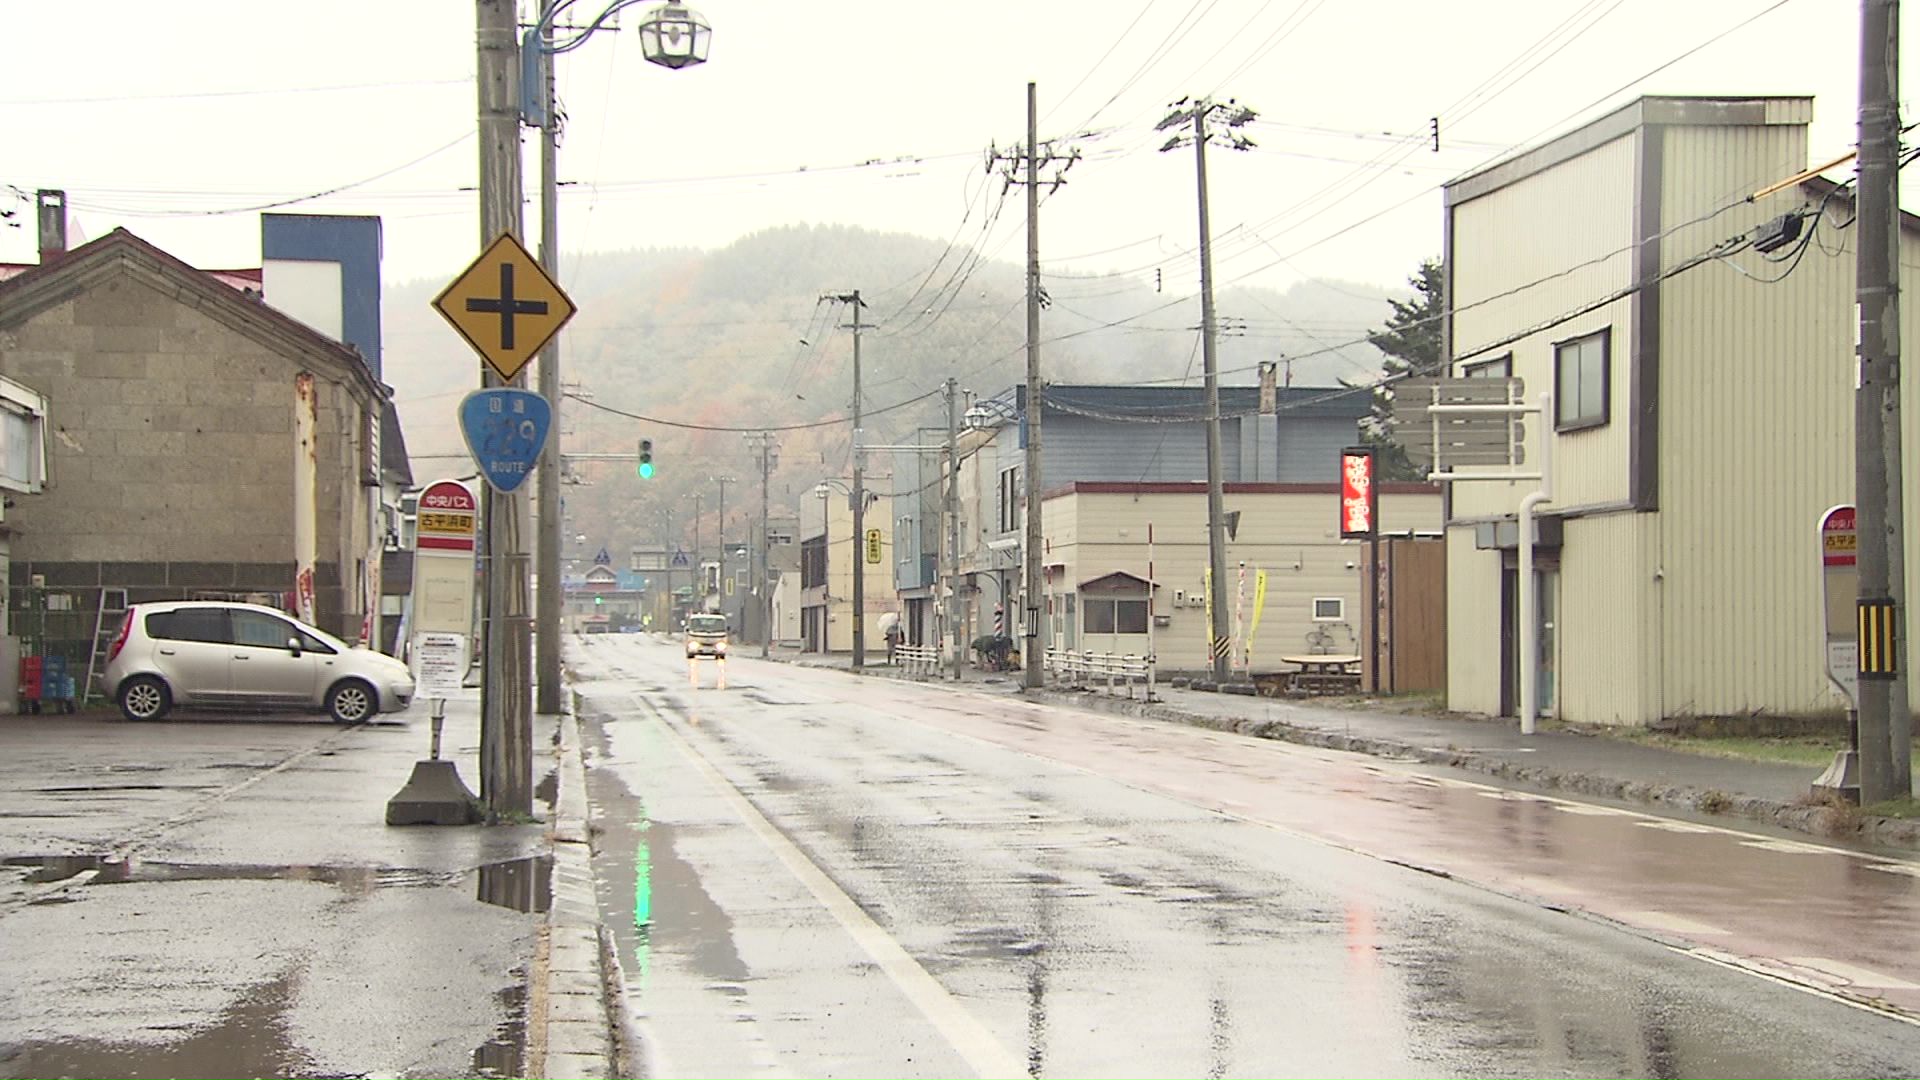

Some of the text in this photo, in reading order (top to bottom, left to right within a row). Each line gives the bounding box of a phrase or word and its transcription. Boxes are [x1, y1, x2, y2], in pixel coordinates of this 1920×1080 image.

[490, 461, 525, 474] ROUTE
[426, 494, 469, 508] 中央バス
[421, 513, 472, 528] 古平浜町
